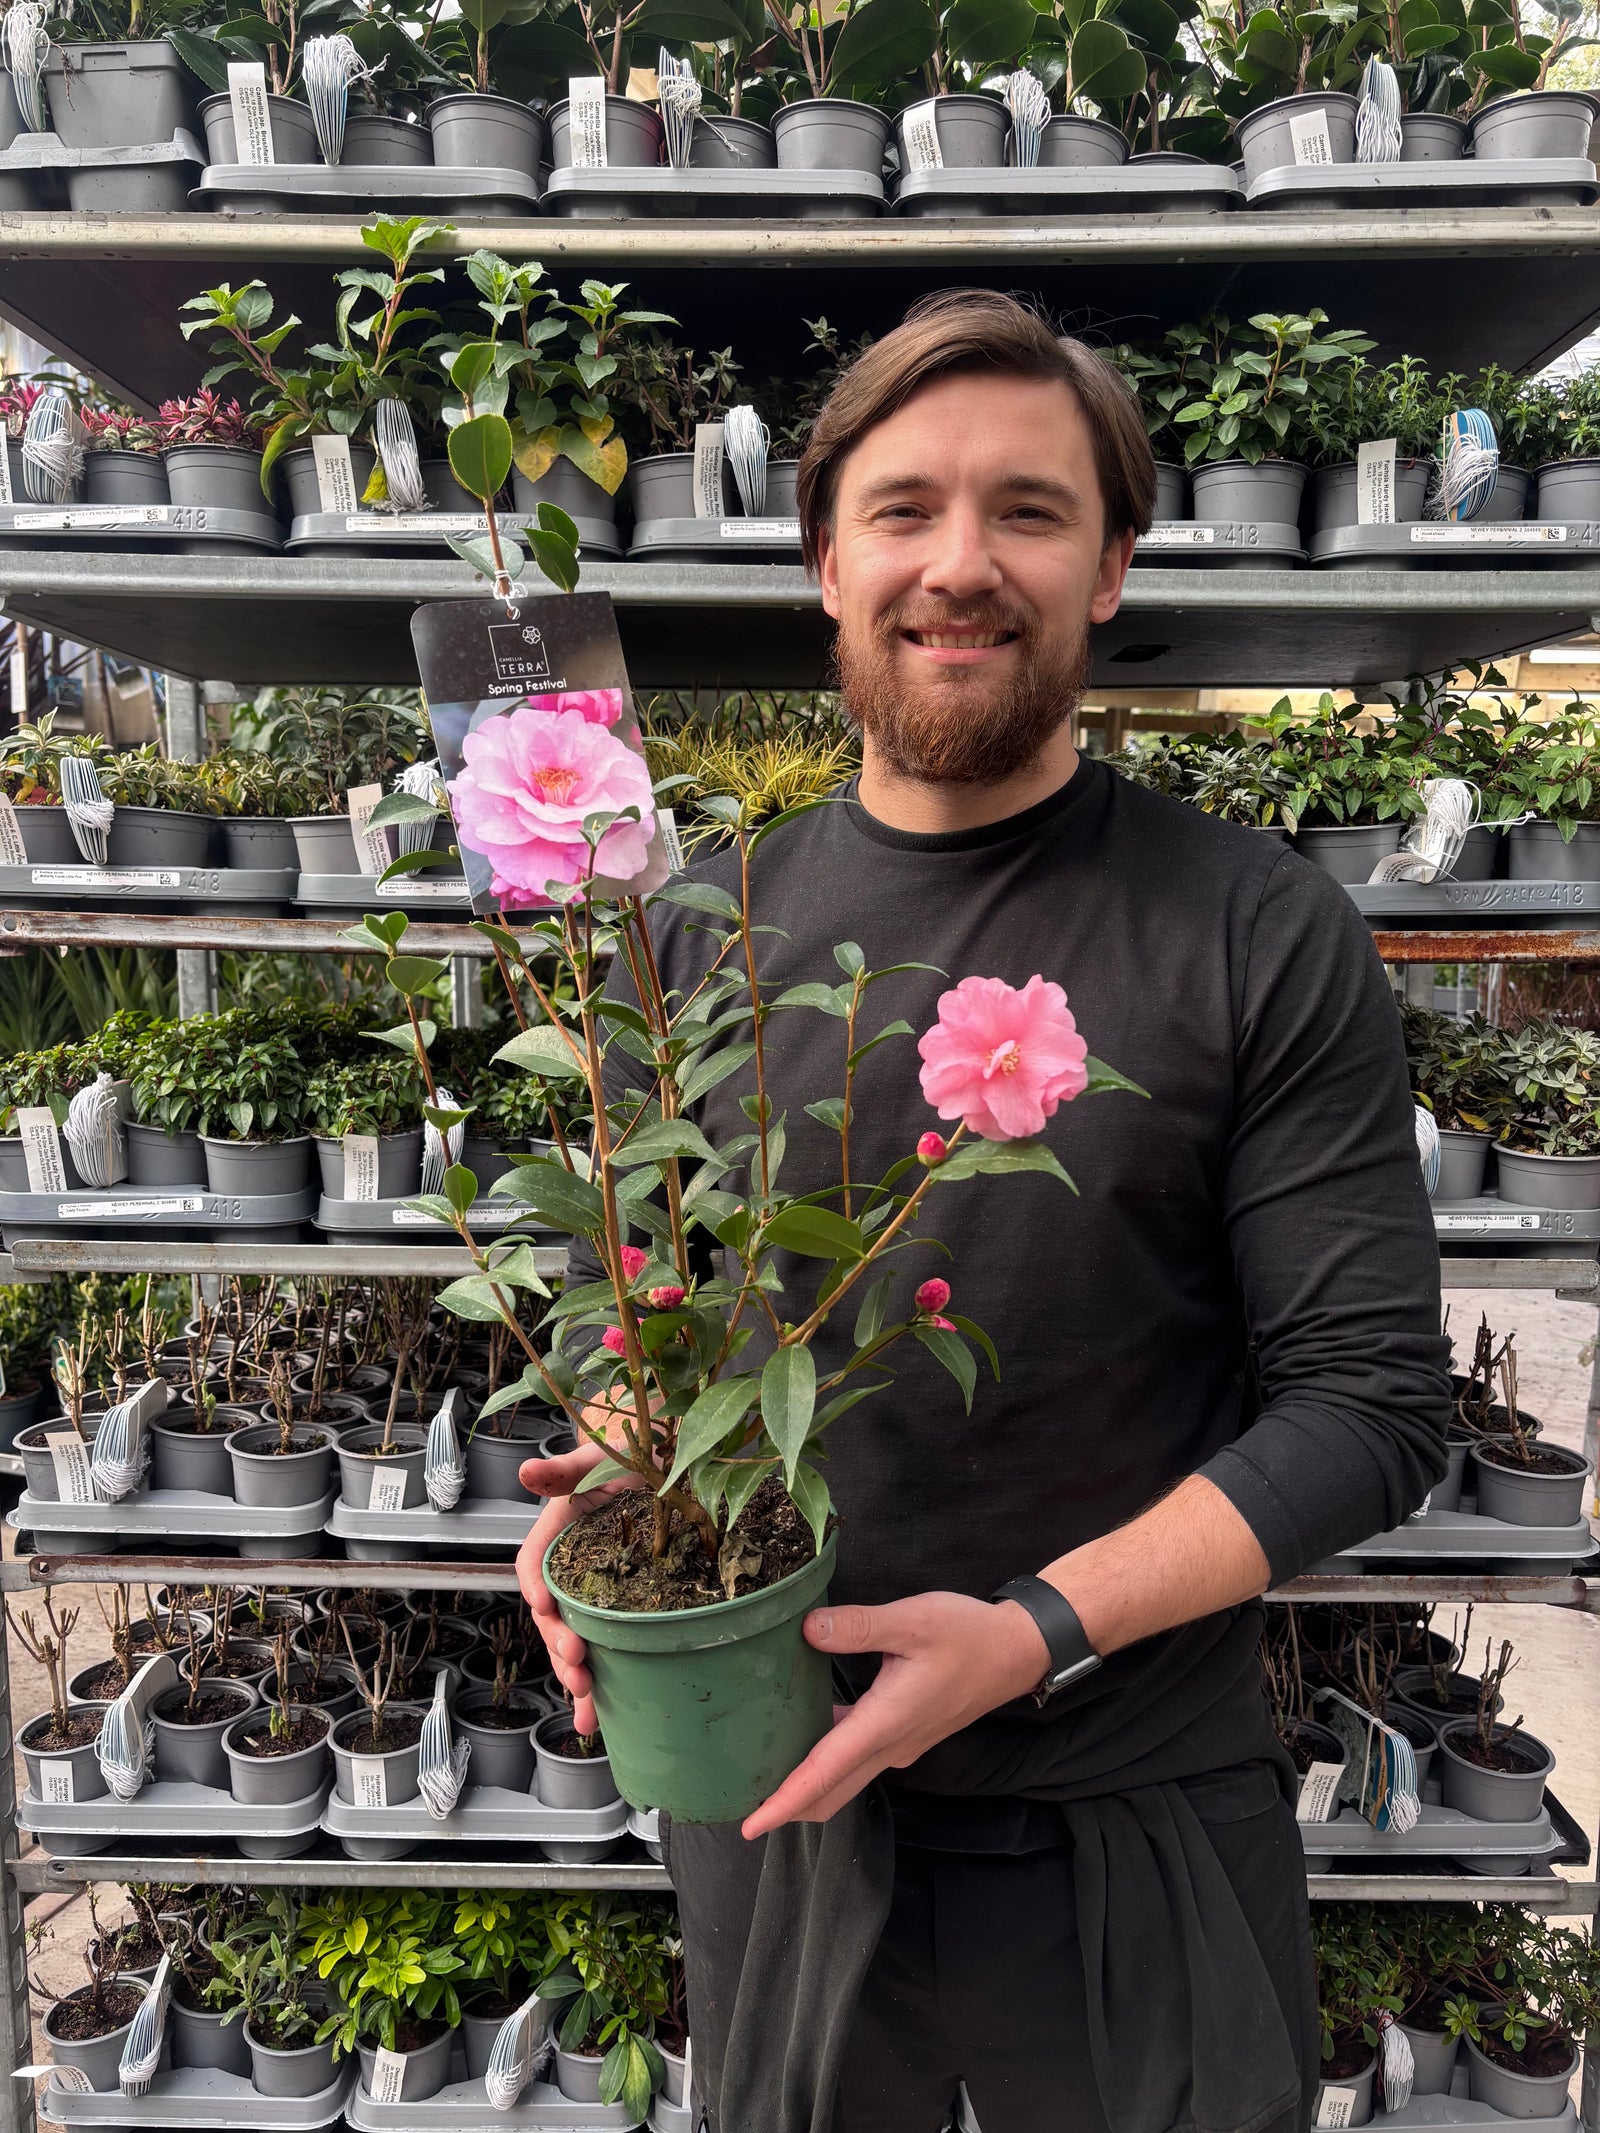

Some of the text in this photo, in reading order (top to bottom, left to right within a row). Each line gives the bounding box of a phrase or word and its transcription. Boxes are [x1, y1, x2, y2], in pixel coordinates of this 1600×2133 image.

[341, 458, 349, 481] Fuchsia
[173, 509, 207, 530] 418
[1224, 524, 1258, 546] 418
[501, 662, 543, 674] TERRA
[488, 678, 566, 696] Spring Festival
[188, 871, 220, 893] 418
[1505, 884, 1535, 902] PACK
[1550, 882, 1584, 905] 418
[210, 1199, 242, 1219] 418
[1541, 1212, 1574, 1233] 418
[74, 1444, 83, 1464] Hydrangea
